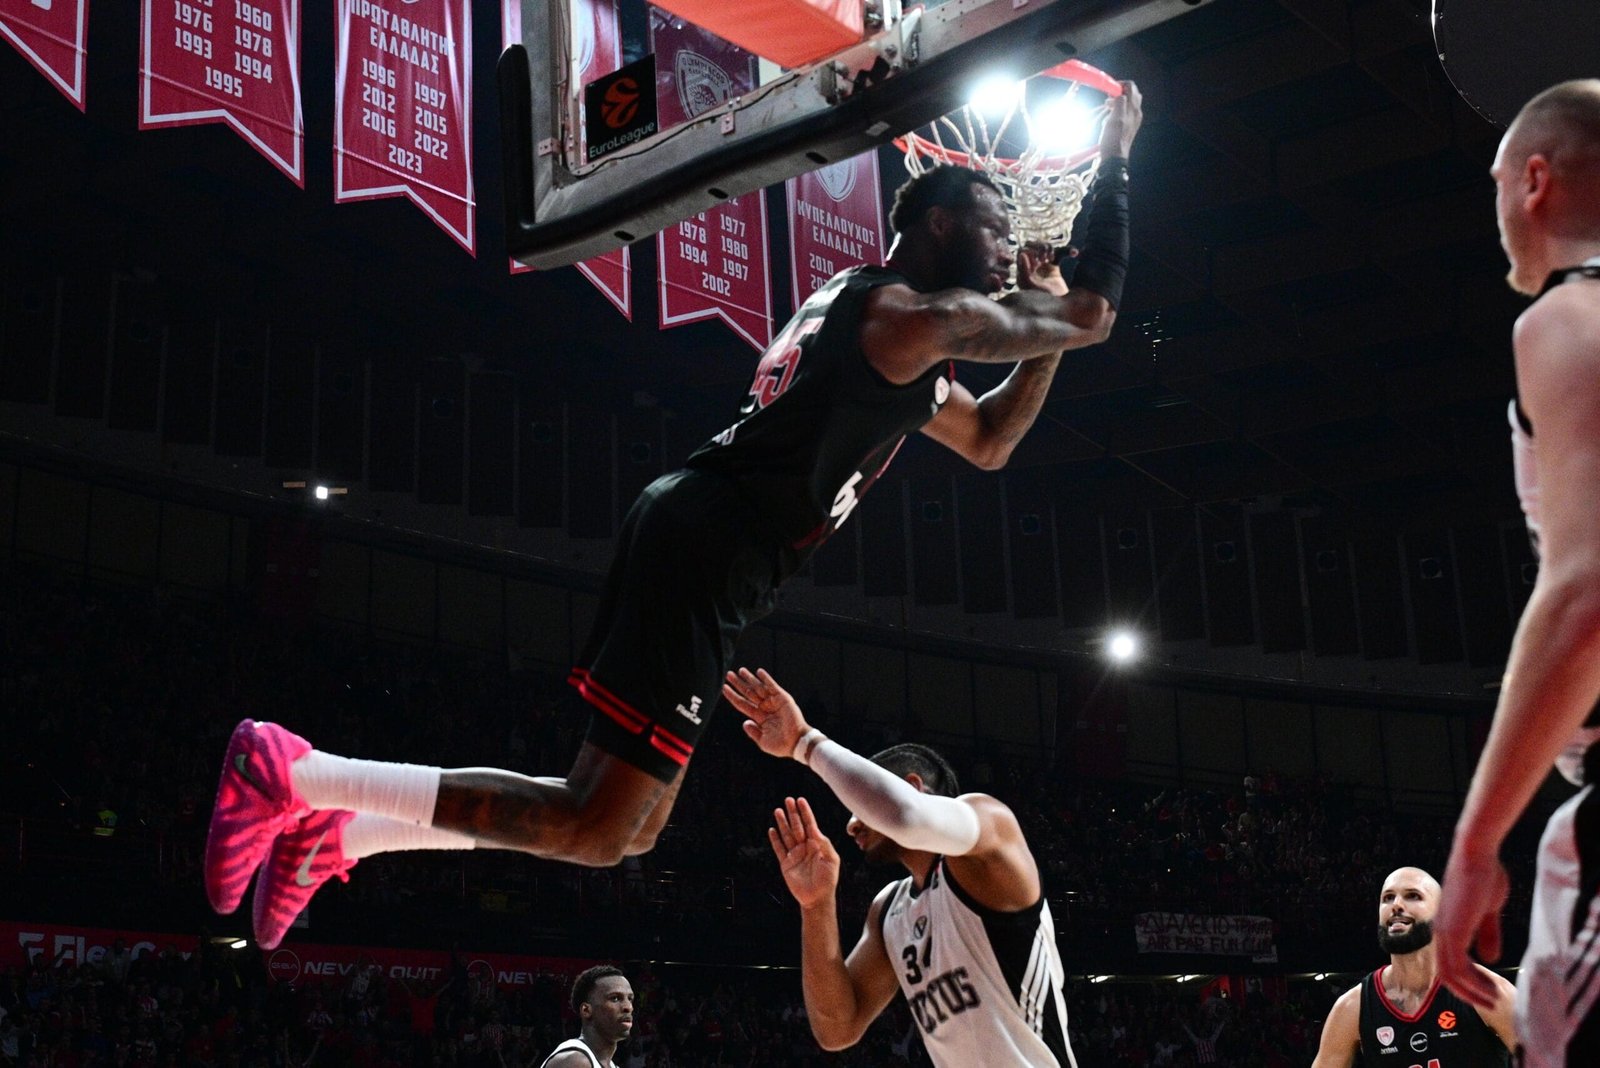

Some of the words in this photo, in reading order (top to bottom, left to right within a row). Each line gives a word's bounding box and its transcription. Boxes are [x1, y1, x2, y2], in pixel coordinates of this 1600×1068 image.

[174, 0, 213, 33] 1976
[235, 25, 272, 58] 1978
[235, 0, 272, 32] 1960
[351, 0, 455, 56] ΠΡΩΤΑΘΛΗΤΗ
[175, 27, 212, 60] 1993
[235, 51, 272, 84] 1994
[370, 26, 439, 75] ΕΛΛΑΔΑΣ
[205, 66, 243, 98] 1995
[362, 58, 396, 88] 1996
[415, 81, 447, 110] 1997
[362, 83, 396, 113] 2012
[415, 106, 447, 135] 2015
[362, 108, 396, 138] 2016
[414, 130, 448, 160] 2022
[589, 121, 655, 158] EuroLeague
[388, 144, 423, 174] 2023
[679, 221, 707, 244] 1978
[721, 235, 748, 260] 1980
[720, 213, 746, 237] 1977
[797, 200, 876, 247] ΚΥΠΕΛΛΟΥΧΟΣ
[813, 225, 864, 260] ΕΛΛΑΔΑΣ
[680, 241, 708, 267] 1994
[723, 258, 749, 281] 1997
[809, 253, 834, 276] 2010
[702, 272, 731, 297] 2002
[389, 965, 442, 980] QUIT
